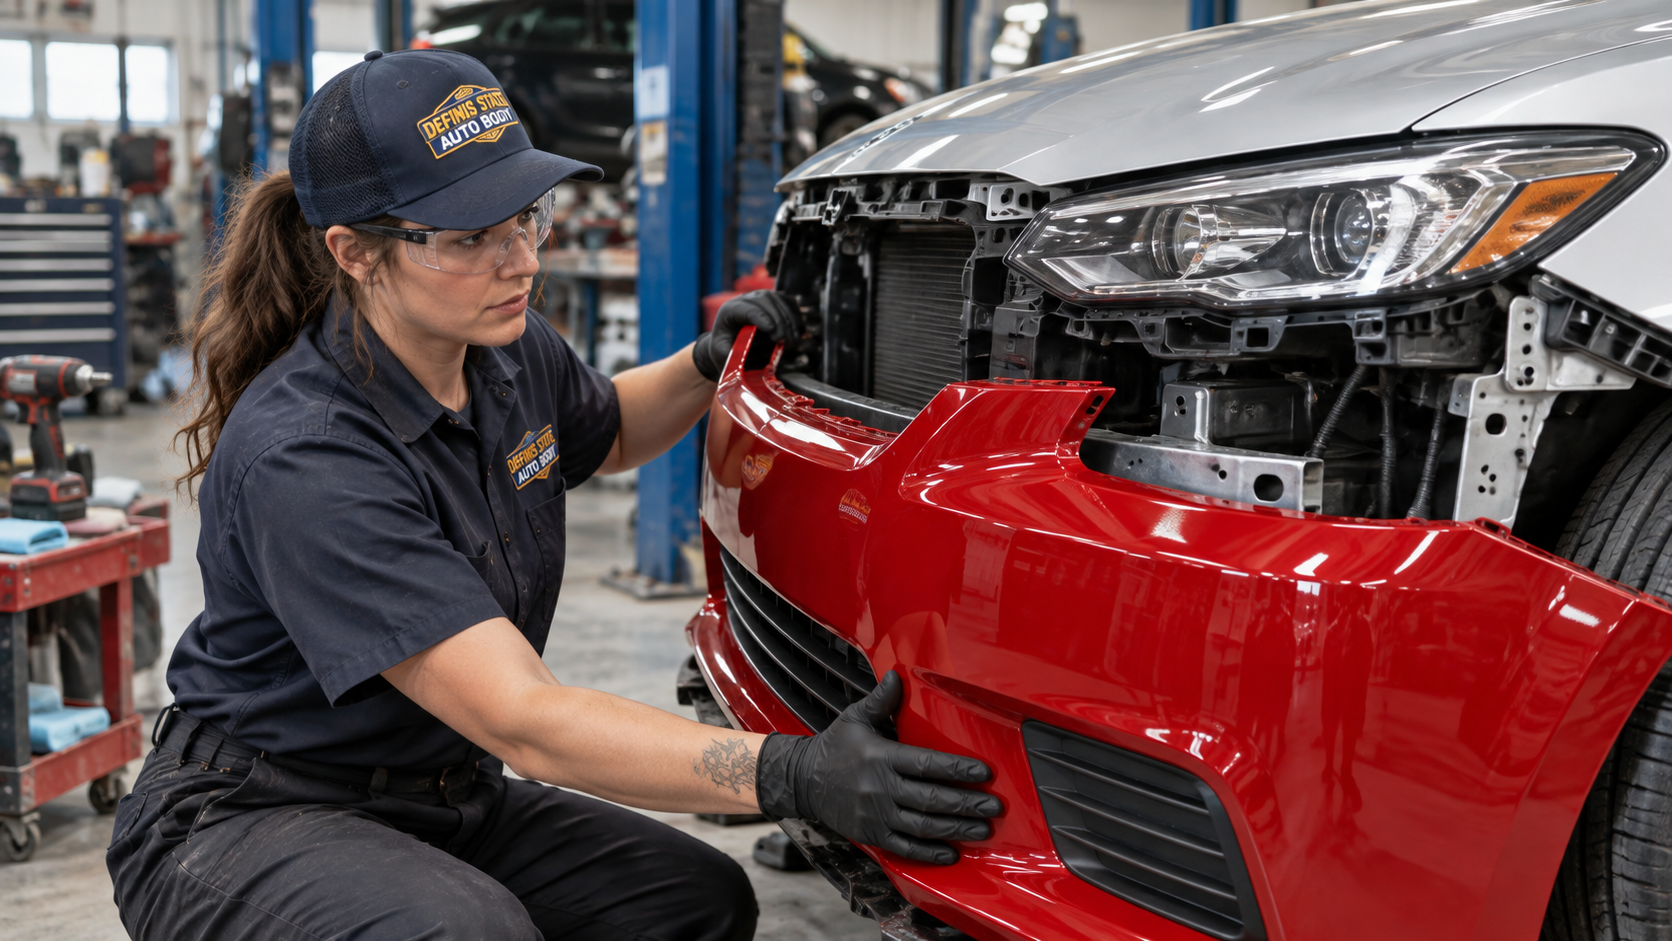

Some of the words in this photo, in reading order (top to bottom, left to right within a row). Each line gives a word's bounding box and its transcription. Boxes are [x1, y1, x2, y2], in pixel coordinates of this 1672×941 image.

[440, 120, 480, 151] AUTO
[480, 108, 513, 129] BODY
[518, 460, 539, 485] AUTO
